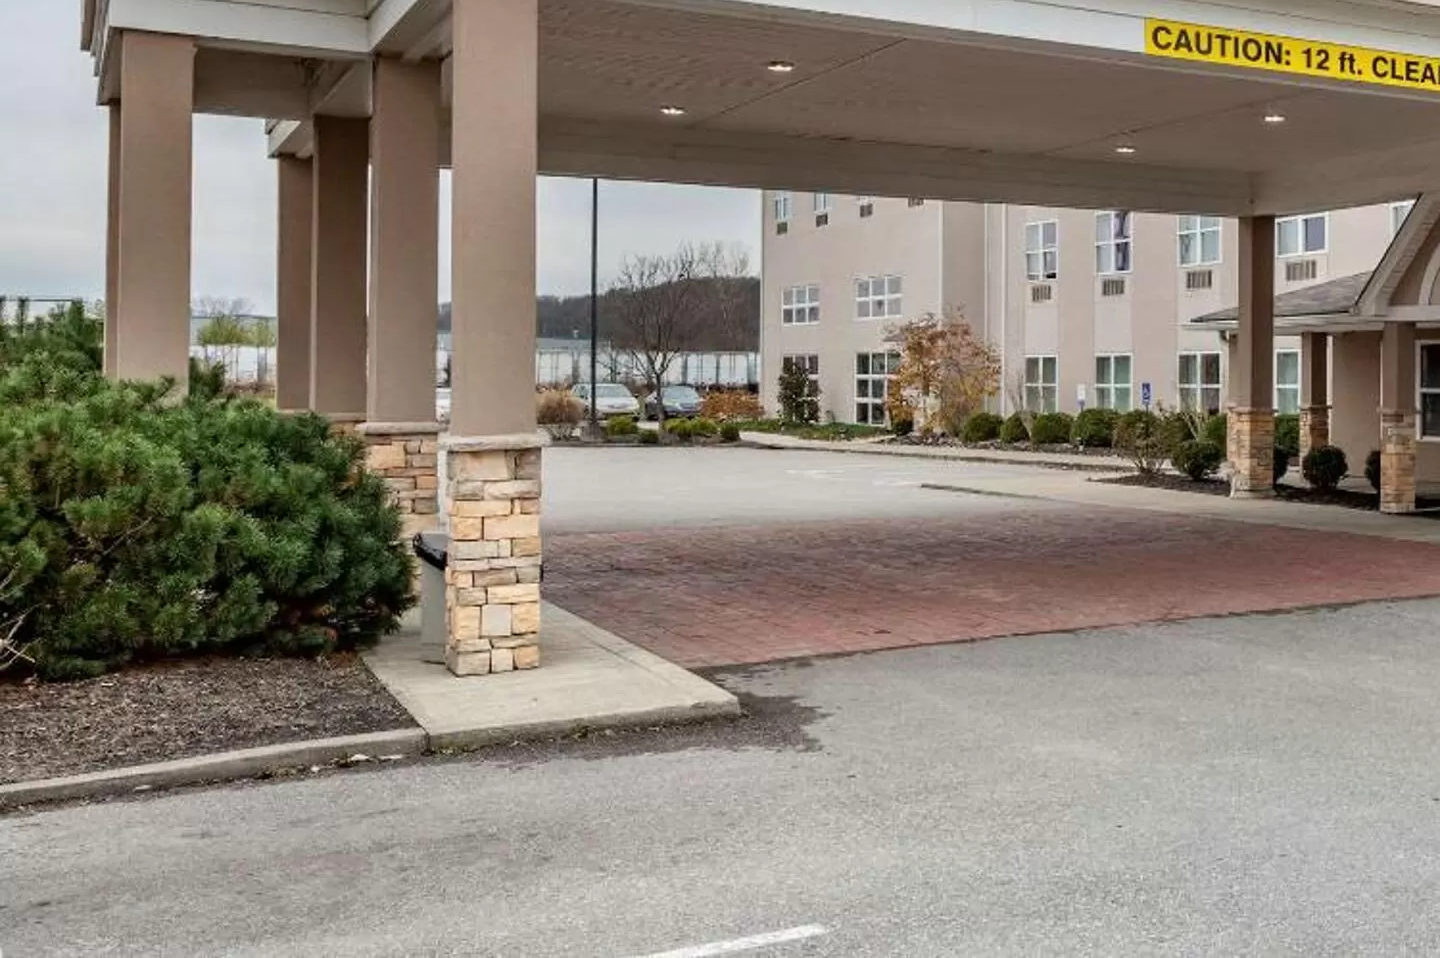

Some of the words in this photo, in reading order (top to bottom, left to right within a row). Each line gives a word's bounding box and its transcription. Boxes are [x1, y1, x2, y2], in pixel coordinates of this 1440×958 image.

[1151, 25, 1291, 66] CAUTION:
[1302, 47, 1330, 71] 12
[1338, 51, 1362, 76] ft.
